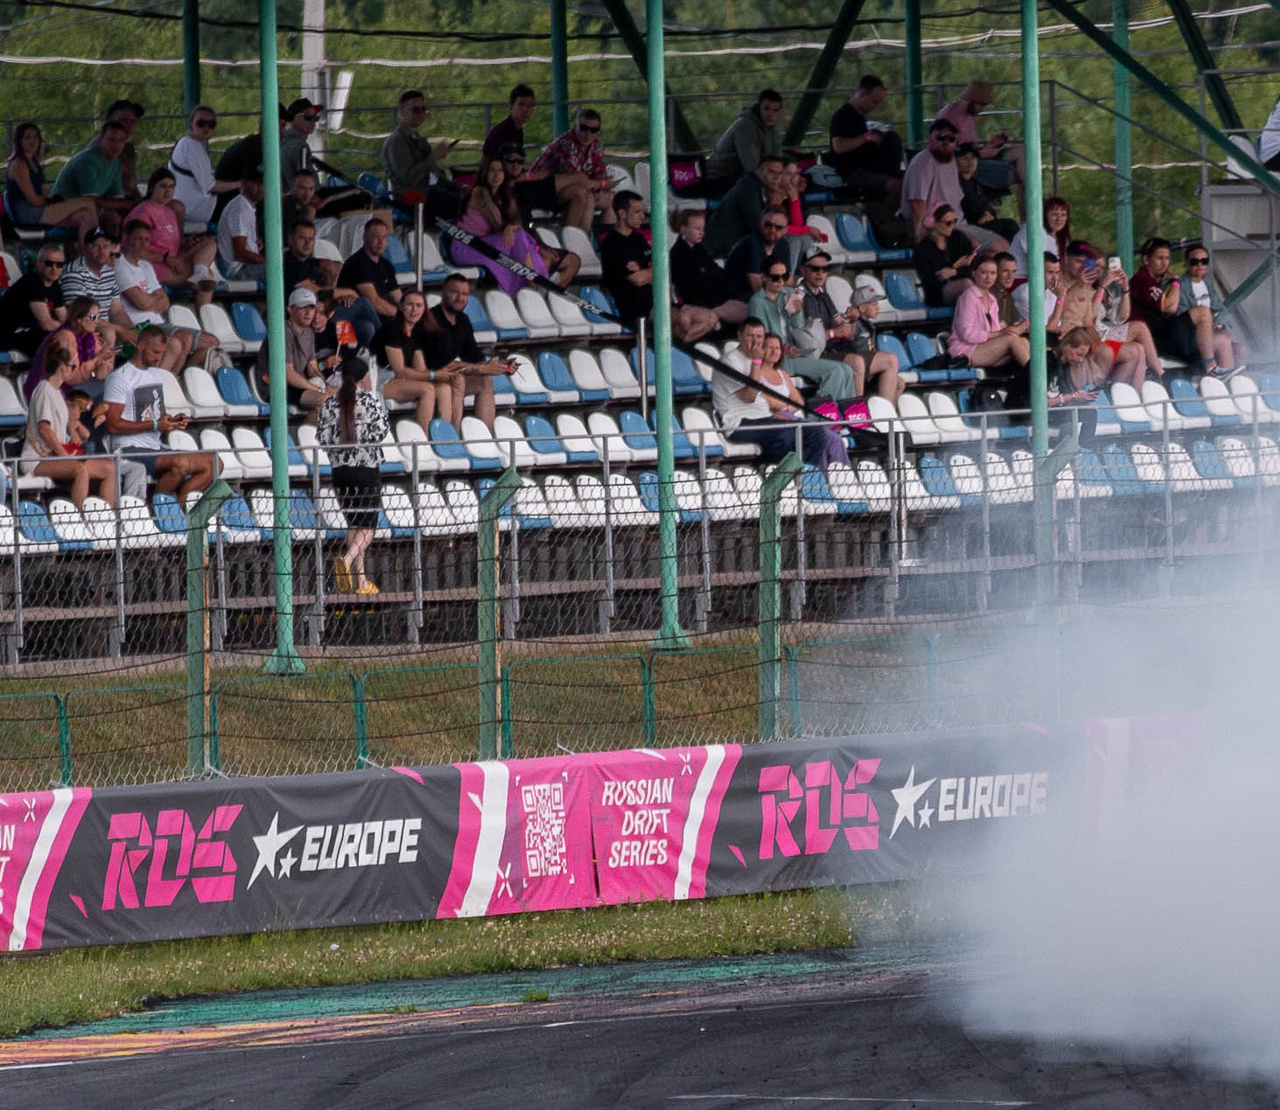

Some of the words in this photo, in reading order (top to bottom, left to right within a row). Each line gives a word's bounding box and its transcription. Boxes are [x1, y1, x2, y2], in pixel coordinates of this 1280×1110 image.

[448, 225, 472, 244] RDS
[510, 262, 538, 281] RDS
[601, 777, 674, 806] RUSSIAN
[621, 808, 671, 836] DRIFT
[758, 758, 882, 860] RDS
[937, 771, 1049, 823] EUROPE
[101, 804, 244, 911] RDS
[299, 818, 422, 872] EUROPE
[608, 838, 668, 868] SERIES
